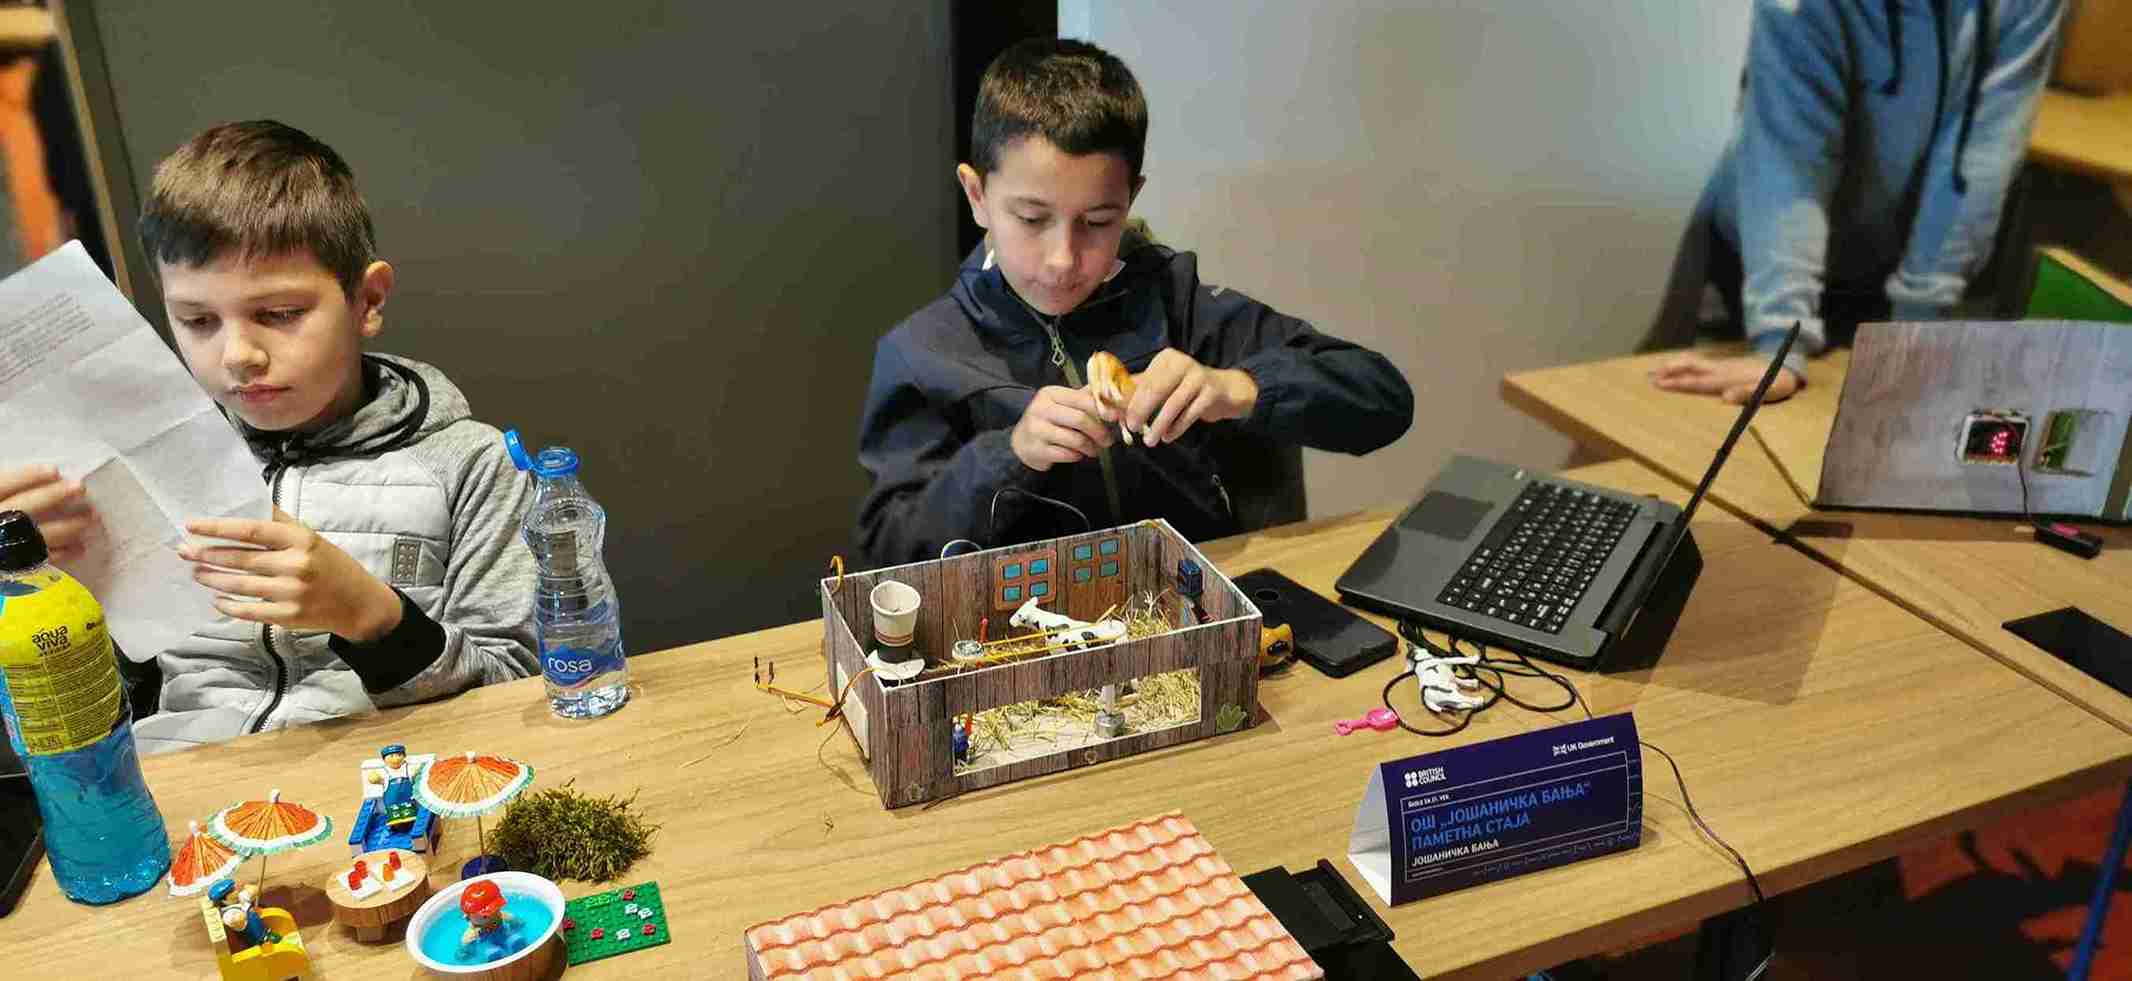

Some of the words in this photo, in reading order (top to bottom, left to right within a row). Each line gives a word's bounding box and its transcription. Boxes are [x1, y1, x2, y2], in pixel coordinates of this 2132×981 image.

[32, 626, 68, 645] aqua
[37, 635, 69, 650] viva
[548, 657, 592, 673] rosa
[1567, 743, 1577, 752] UK
[1418, 766, 1444, 779] BRITISH
[1418, 773, 1447, 785] COUNCIL
[1411, 814, 1436, 832] ОШ
[1412, 823, 1481, 849] ПАМЕТНА
[1486, 812, 1530, 833] СТАЈА
[1412, 846, 1470, 867] ЈОШАНИЧКА
[1471, 838, 1500, 853] БАЊА
